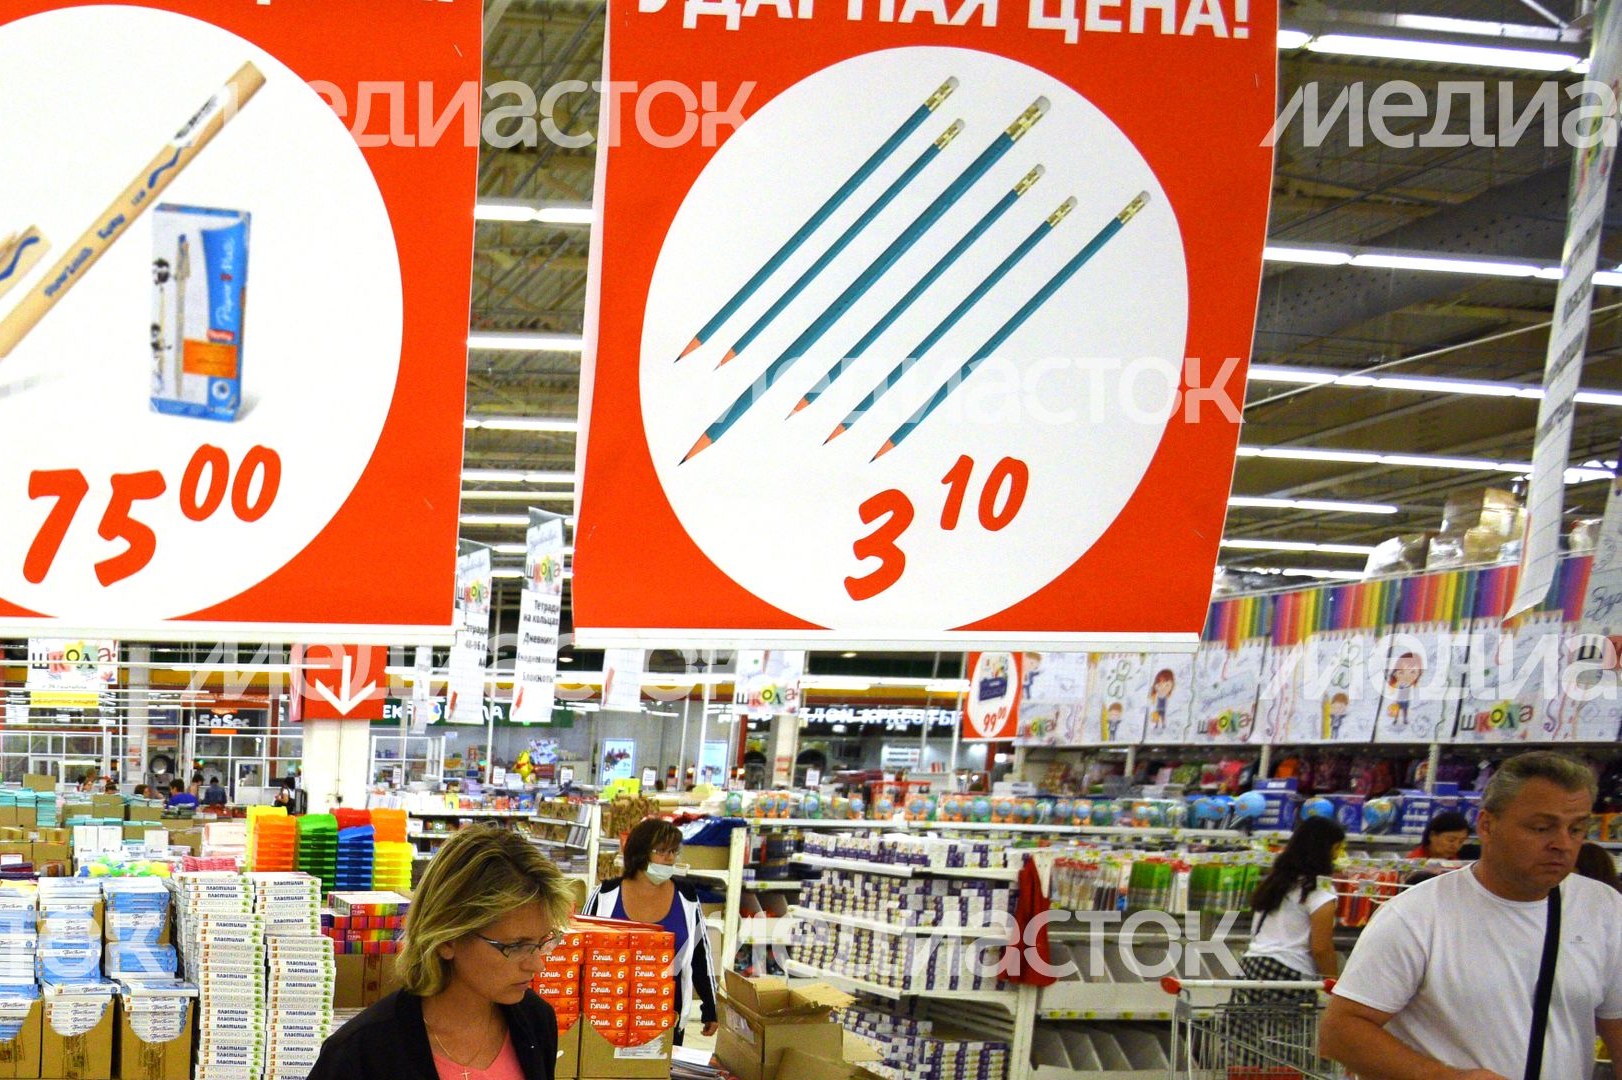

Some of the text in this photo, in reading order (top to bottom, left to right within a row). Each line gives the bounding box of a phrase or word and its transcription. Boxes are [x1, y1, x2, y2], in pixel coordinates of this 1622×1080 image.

[22, 442, 282, 587] 75 00
[844, 453, 1029, 601] 3 10
